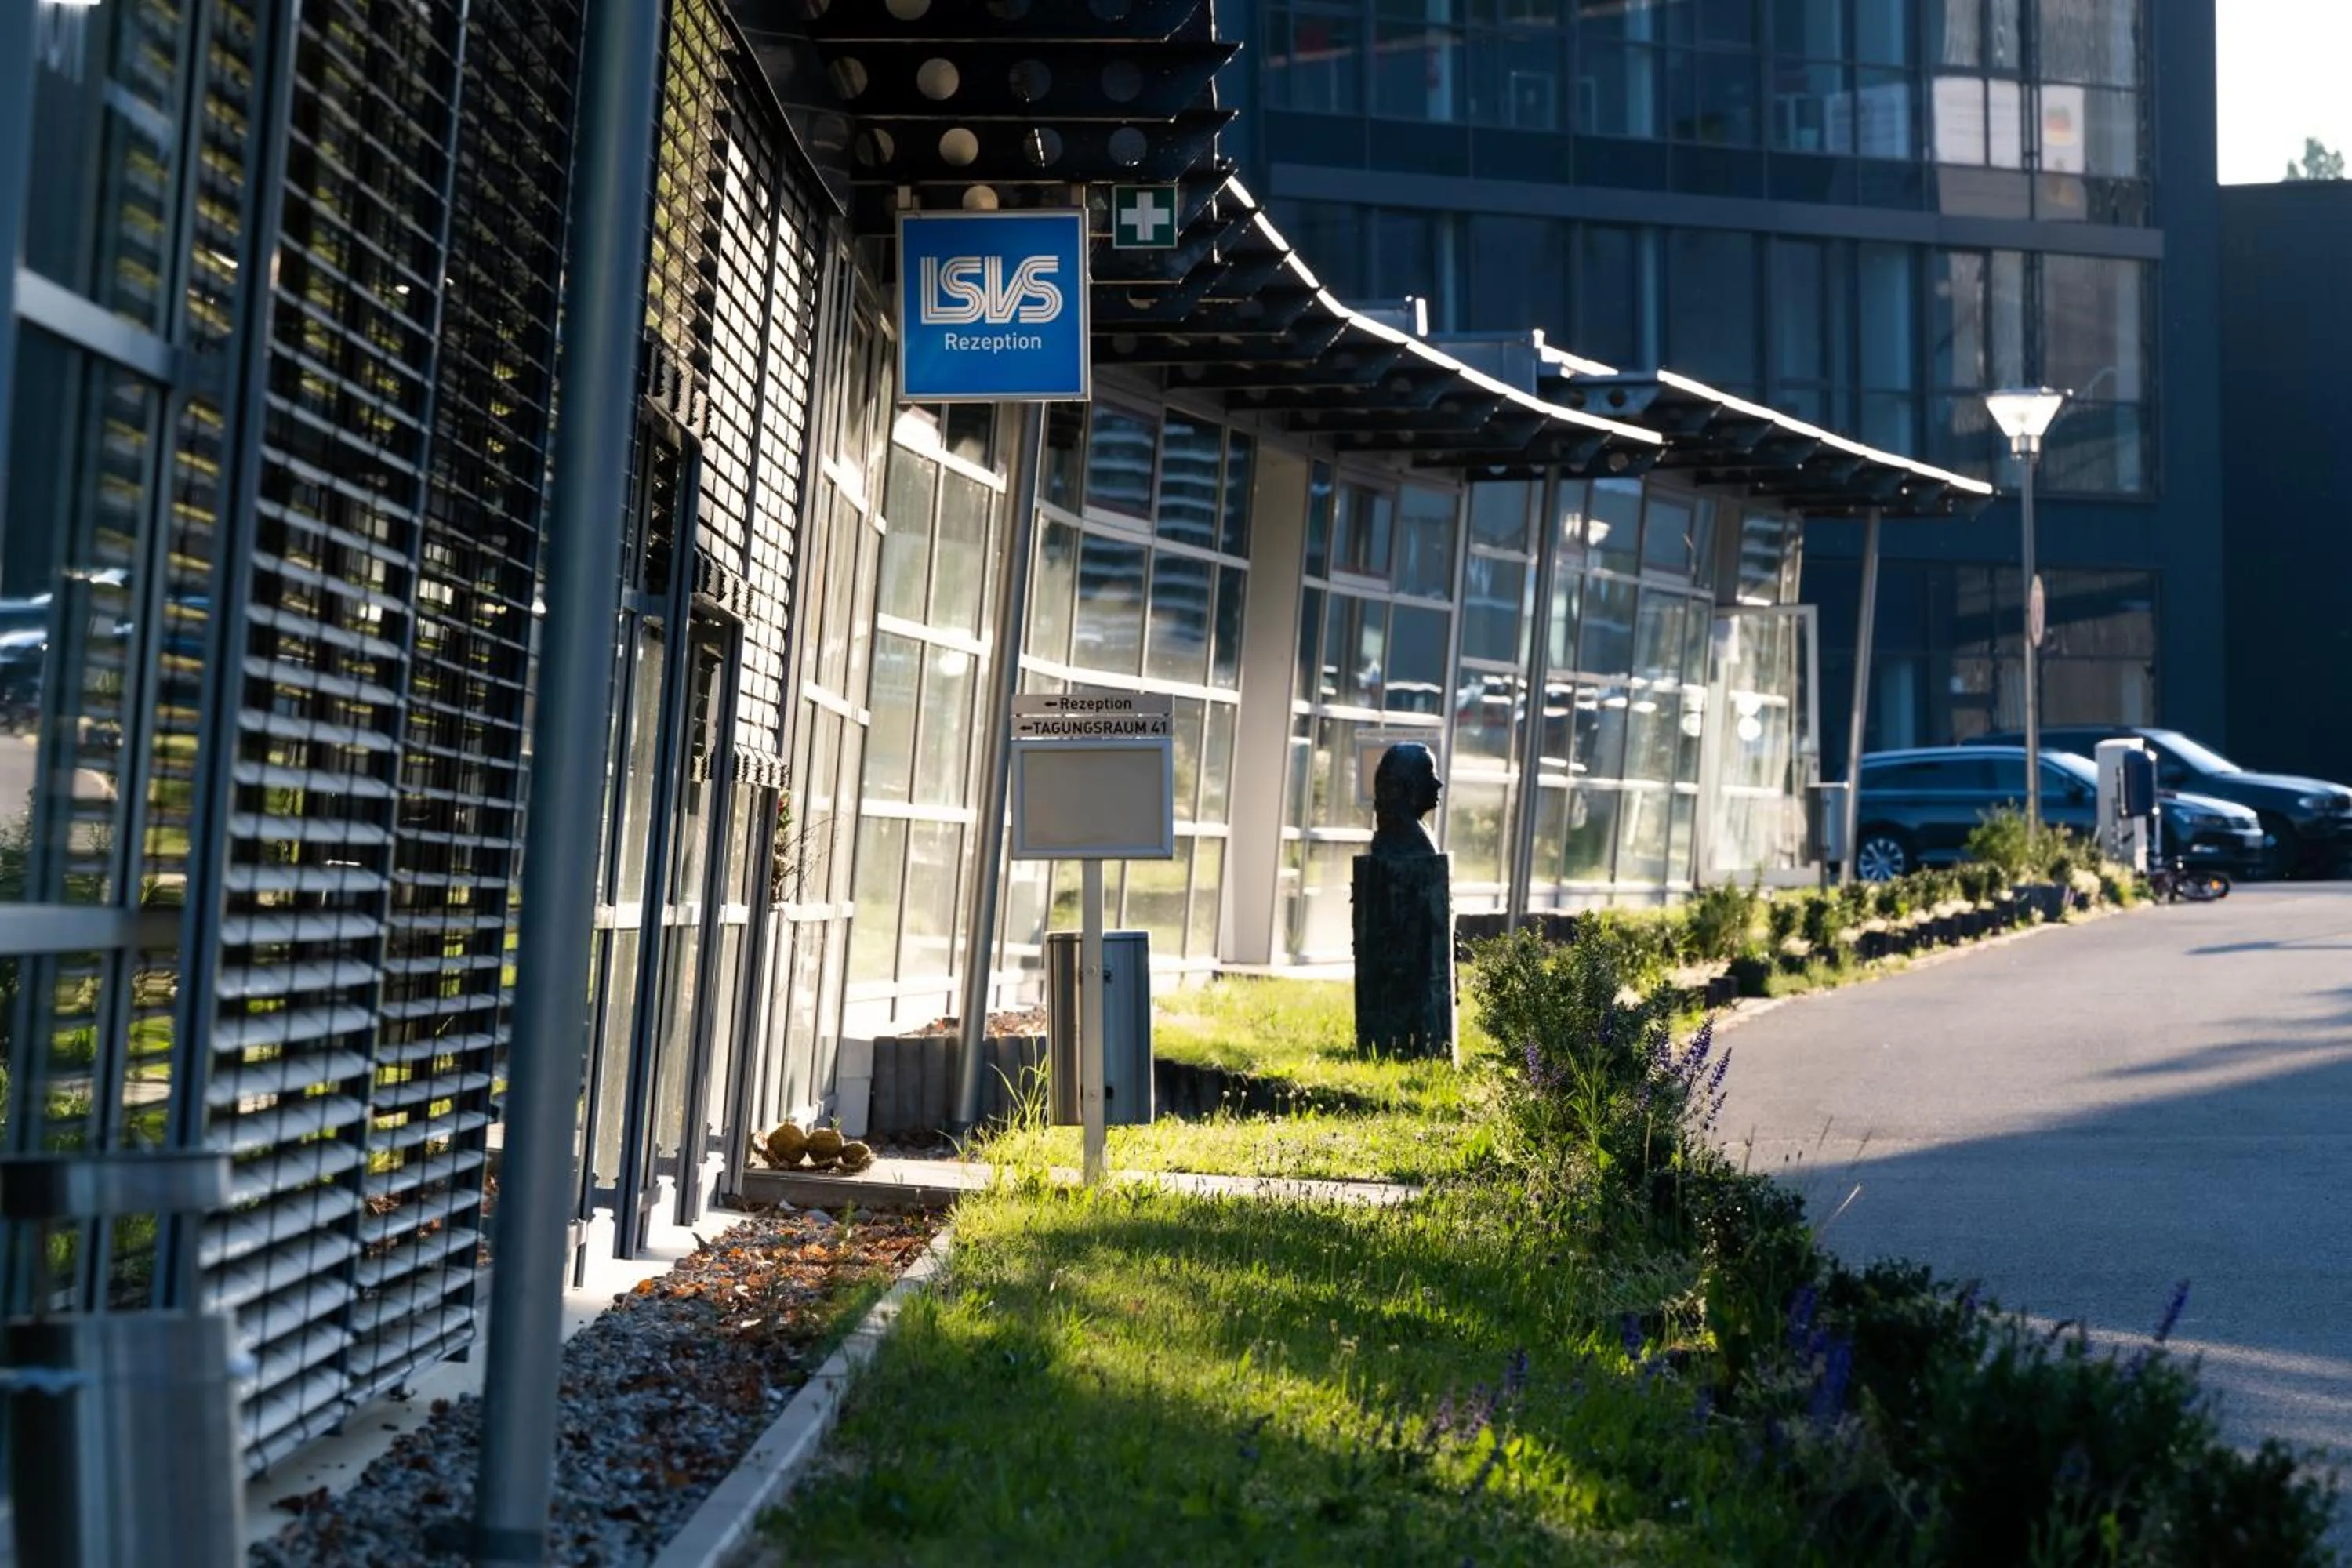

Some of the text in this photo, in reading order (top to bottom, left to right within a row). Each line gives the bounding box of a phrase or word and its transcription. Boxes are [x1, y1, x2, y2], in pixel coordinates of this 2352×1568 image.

[920, 255, 1064, 325] LSVS
[944, 332, 1043, 354] Rezeption
[1059, 697, 1132, 712] Rezeption
[1033, 720, 1167, 735] TAGUNGSRAUM 41
